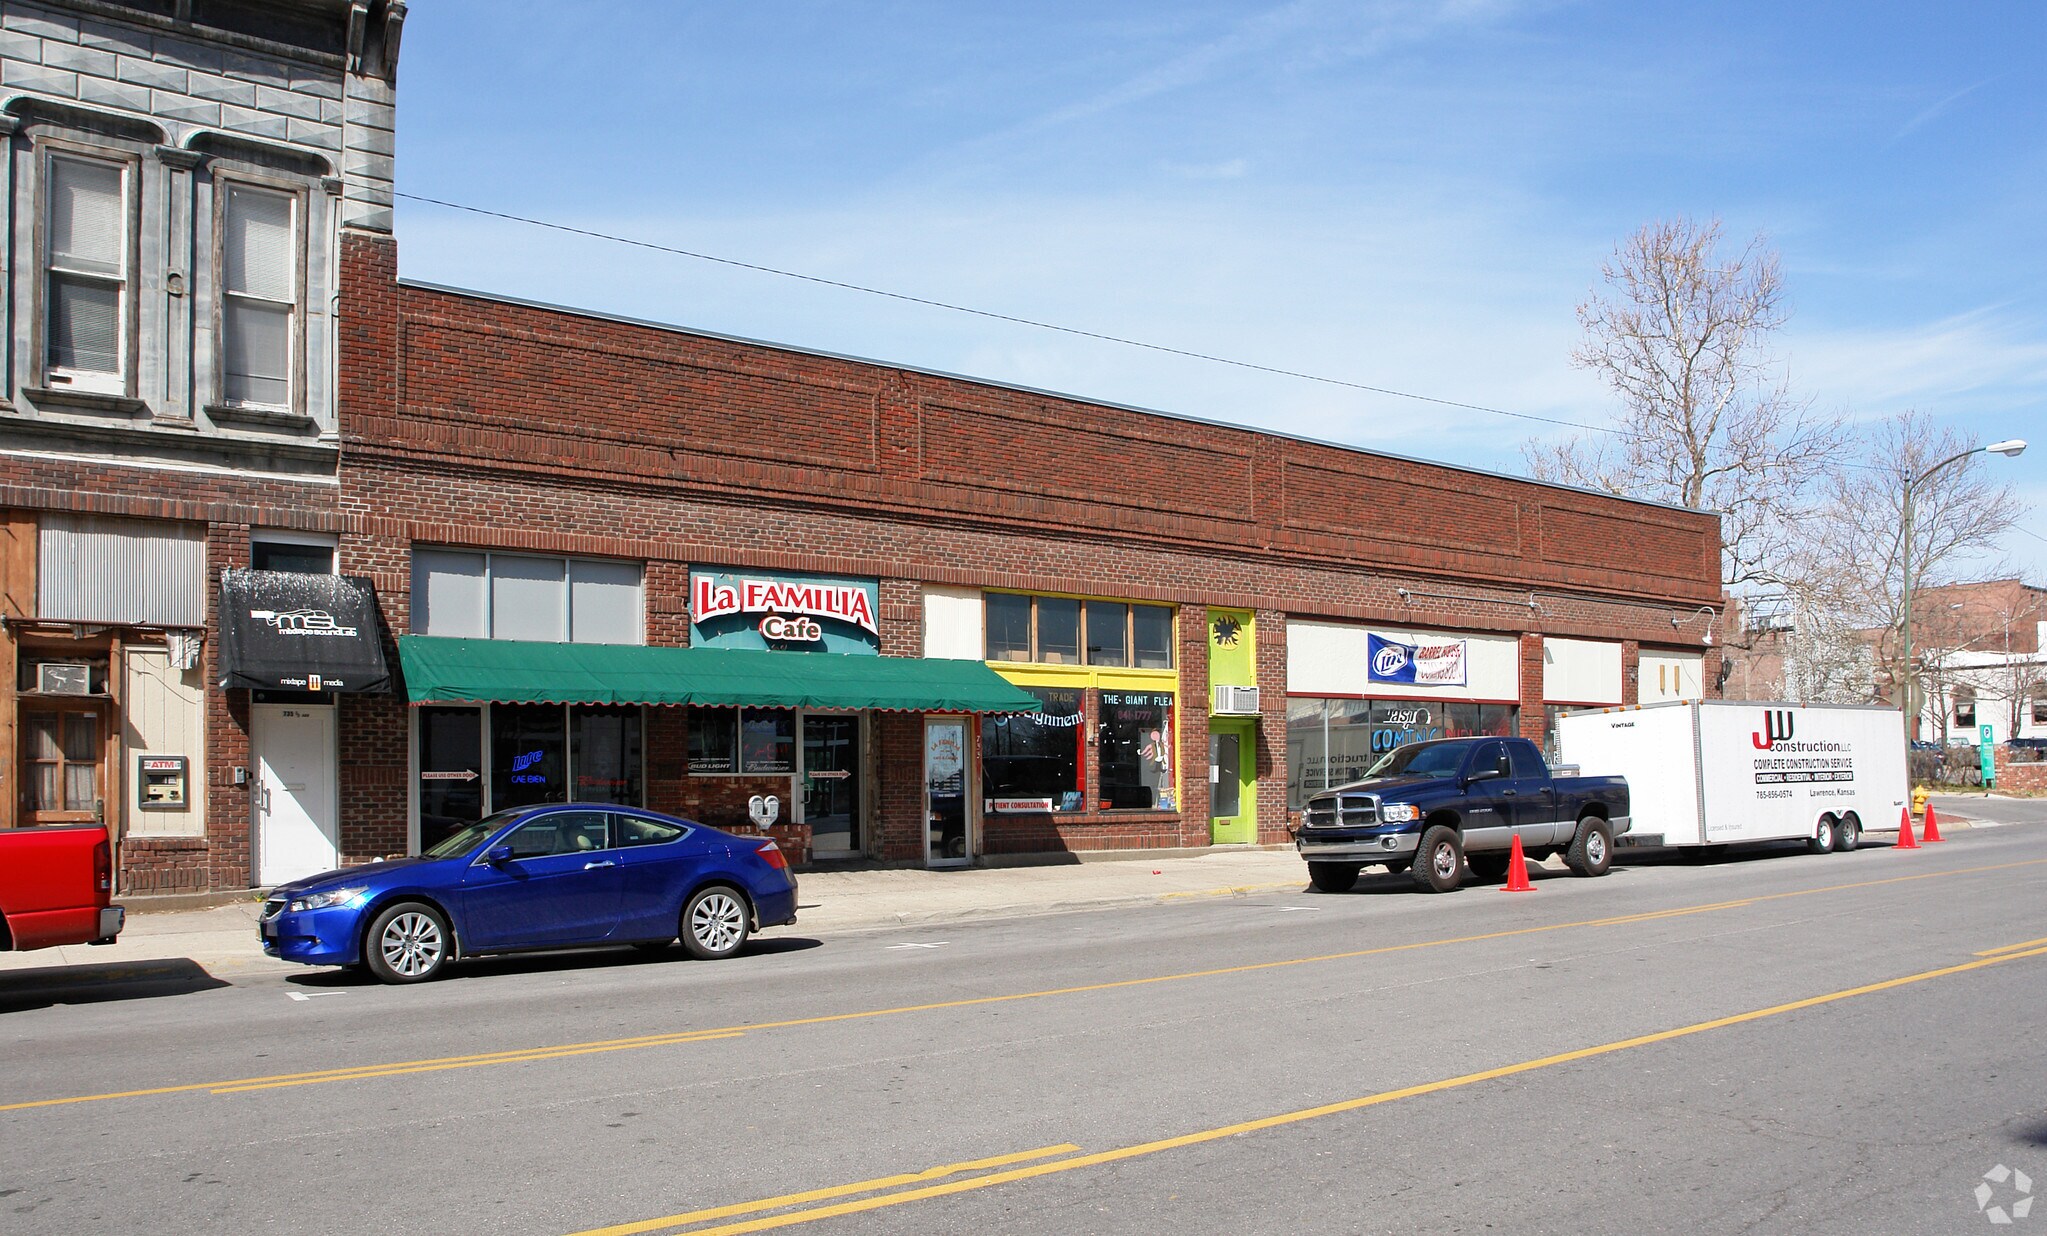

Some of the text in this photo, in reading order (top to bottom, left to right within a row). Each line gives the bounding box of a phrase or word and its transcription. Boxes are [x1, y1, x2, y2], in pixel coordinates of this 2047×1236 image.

[699, 579, 872, 627] La FAMILIA
[763, 618, 820, 639] Cafe
[280, 678, 306, 687] mixtape
[323, 679, 344, 687] media
[1048, 692, 1075, 702] TRADE
[1103, 694, 1173, 706] THE GIANT FLEA
[1769, 740, 1841, 752] construction
[1753, 758, 1853, 770] COMPLETE CONSTRUCTION SERVICE
[511, 775, 546, 784] CAE BIEN
[1837, 788, 1856, 796] Kansas
